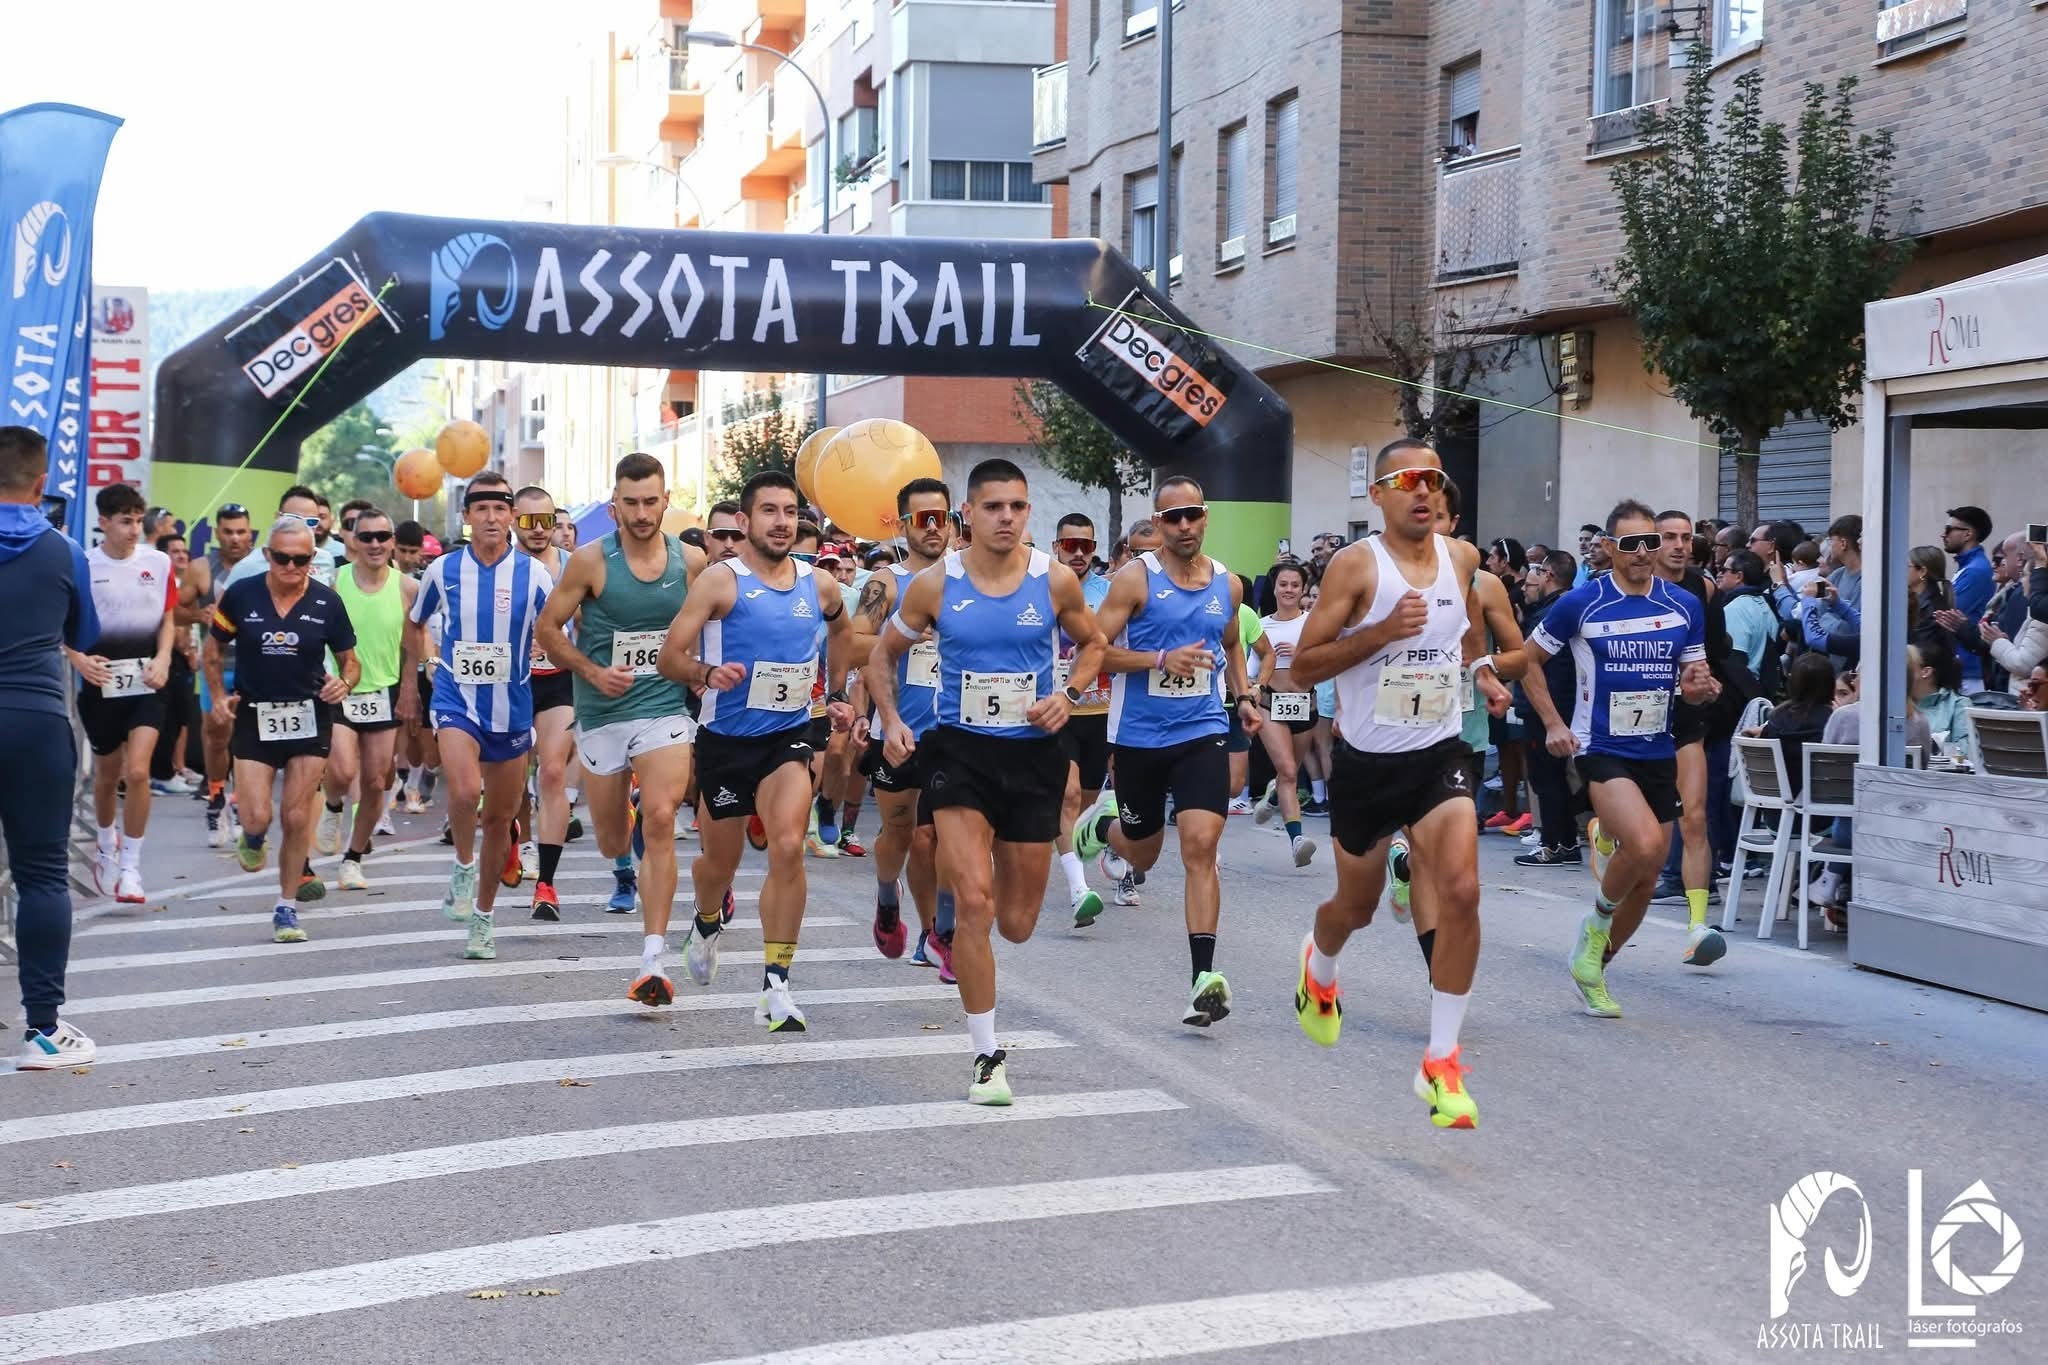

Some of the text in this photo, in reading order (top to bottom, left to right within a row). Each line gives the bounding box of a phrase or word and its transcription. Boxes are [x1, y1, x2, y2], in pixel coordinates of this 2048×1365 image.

[524, 247, 1040, 347] ASSOTA TRAIL
[248, 291, 369, 388] Decgres
[1928, 298, 1981, 366] ROMA
[1107, 315, 1219, 417] Decgres
[10, 323, 58, 434] SOTA
[58, 376, 81, 499] ASSOTA
[623, 648, 659, 667] 186
[1407, 648, 1439, 662] PBF
[1607, 640, 1674, 660] MARTINEZ
[461, 659, 496, 676] 366
[1604, 662, 1673, 672] GUIJARRO
[115, 674, 134, 690] 37
[774, 683, 788, 702] 3
[351, 702, 378, 716] 285
[987, 695, 1000, 717] 5
[1277, 704, 1300, 716] 359
[1411, 693, 1422, 716] 1
[267, 716, 301, 733] 313
[1632, 709, 1643, 727] 7
[1938, 827, 1993, 888] ROMA
